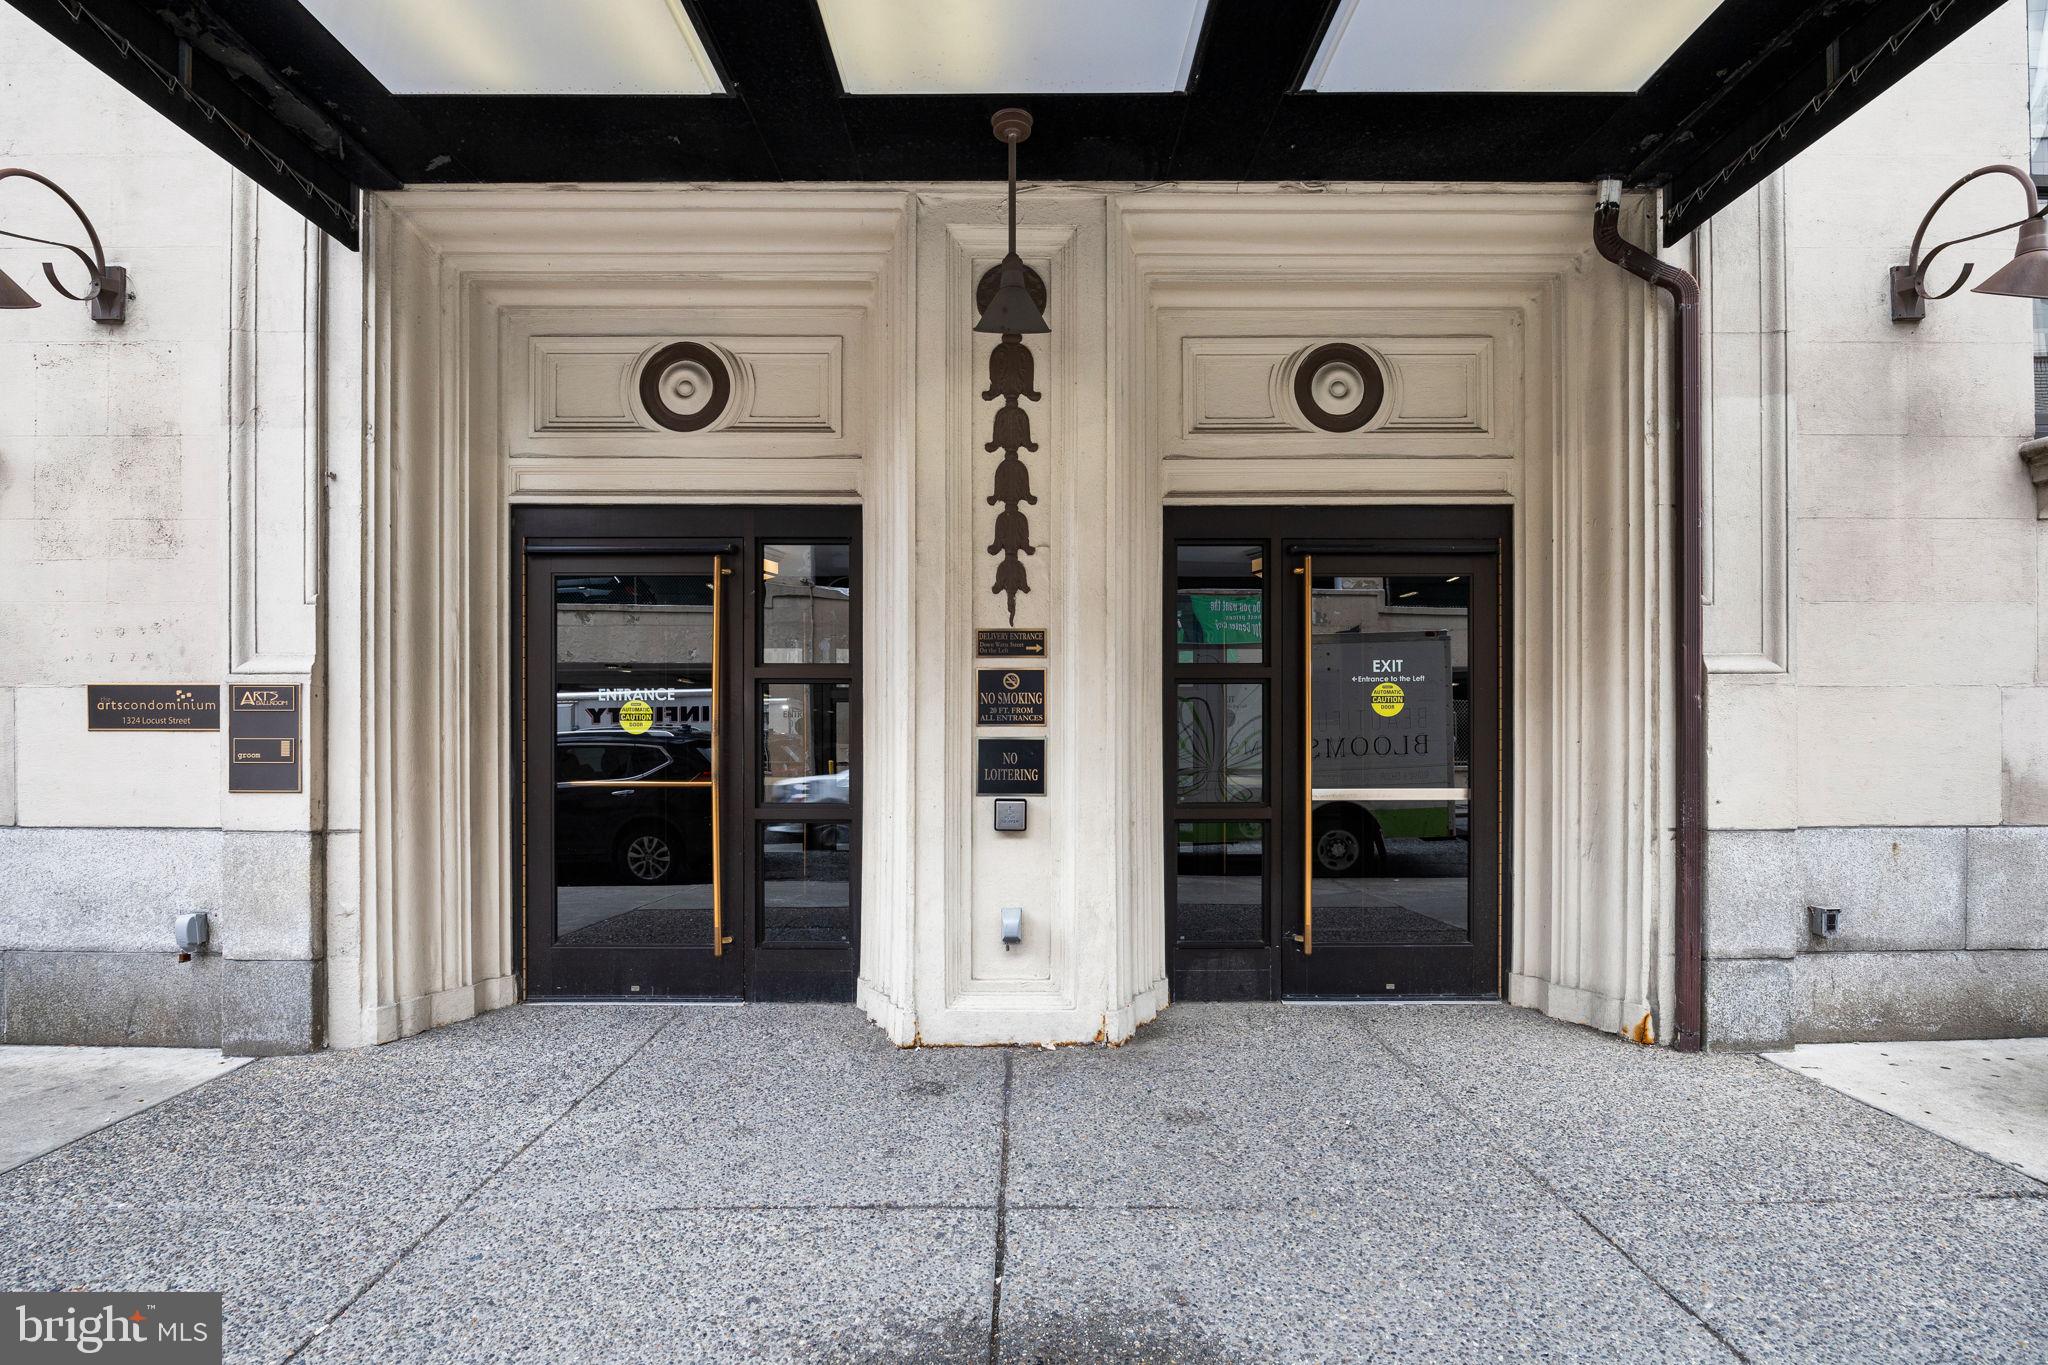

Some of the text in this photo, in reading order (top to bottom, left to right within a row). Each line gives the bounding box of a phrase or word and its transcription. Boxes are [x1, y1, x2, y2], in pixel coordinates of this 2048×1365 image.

[979, 632, 1044, 640] DELIVERY ENTRANCE
[1372, 660, 1404, 672] EXIT
[240, 691, 279, 706] ARTS
[598, 688, 675, 701] ENTRANCE
[980, 692, 1042, 704] NO SMOKING
[96, 698, 216, 710] artscondominium
[142, 717, 167, 725] Locust
[168, 717, 191, 725] Street
[238, 752, 260, 760] groom
[1002, 752, 1018, 764] NO
[984, 769, 1038, 780] LOITERING
